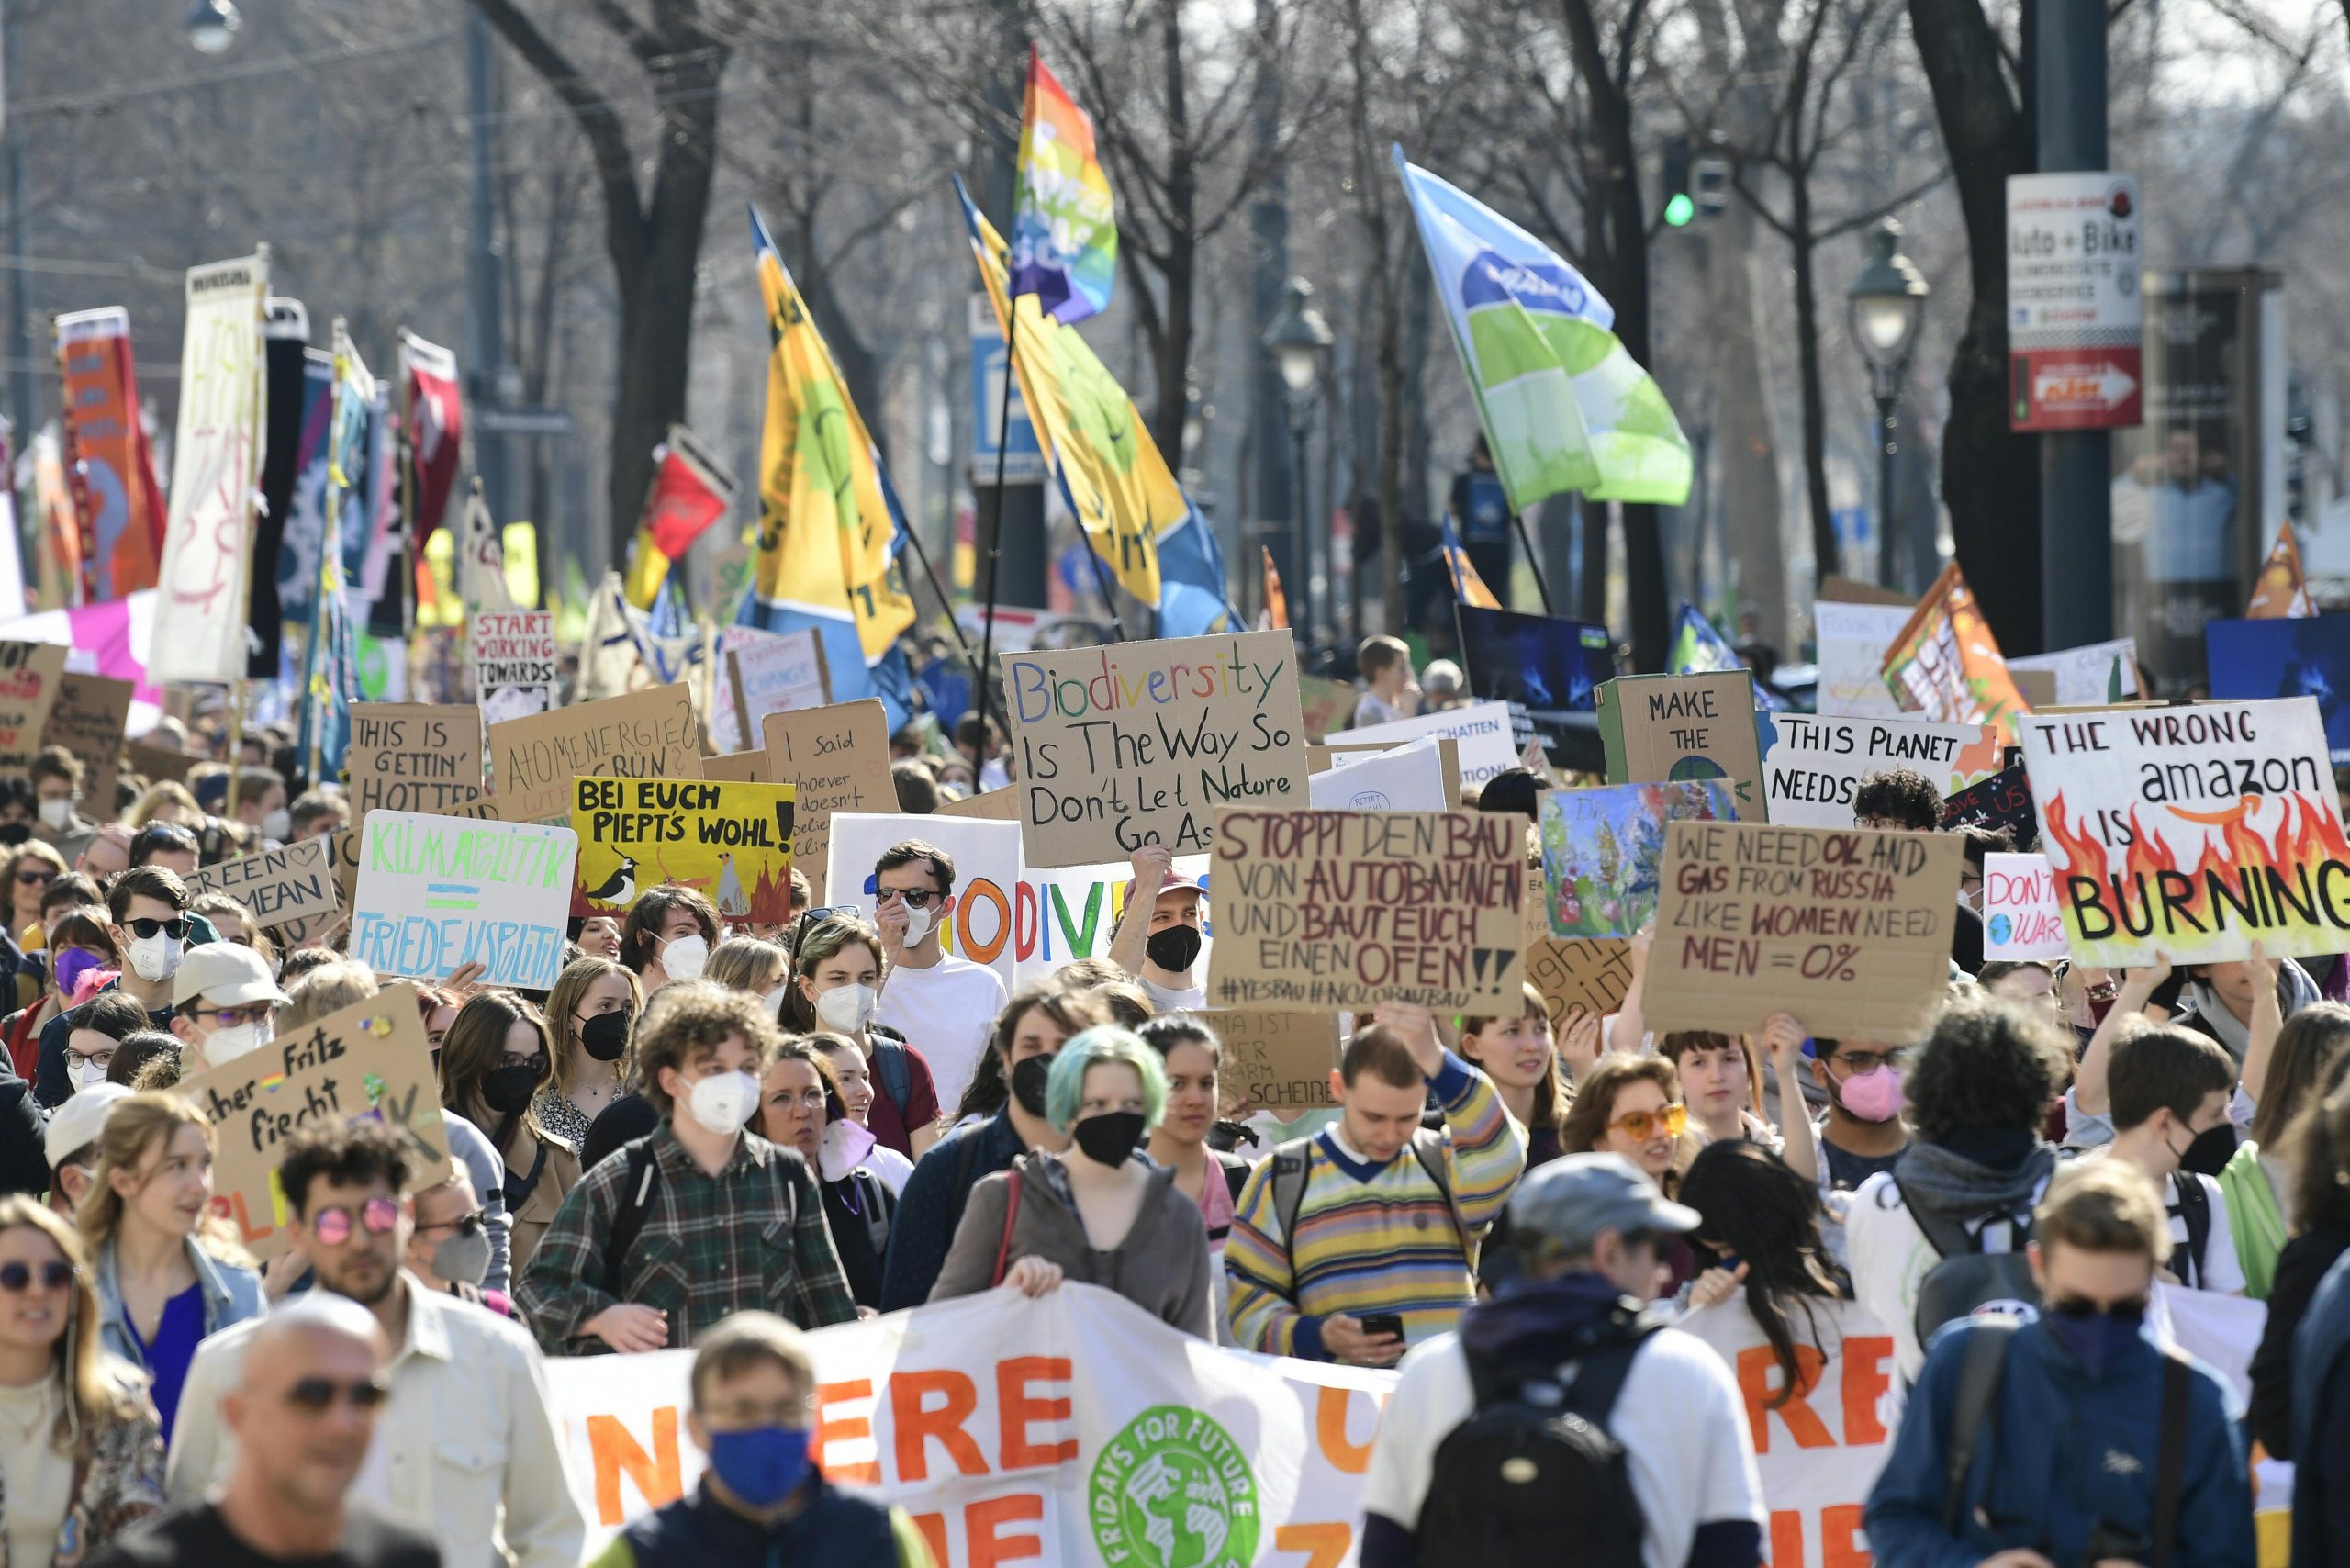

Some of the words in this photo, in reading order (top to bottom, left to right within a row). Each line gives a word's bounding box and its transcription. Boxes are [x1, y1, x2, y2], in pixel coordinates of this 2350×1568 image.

[477, 614, 553, 635] START
[475, 639, 553, 660] WORKING
[478, 663, 554, 683] TOWARDS
[1013, 640, 1283, 723] Biodiversity
[1649, 690, 1719, 722] MAKE
[354, 718, 405, 749] THIS
[424, 722, 448, 748] IS
[786, 731, 792, 762] I
[1065, 720, 1155, 775] The
[1156, 706, 1238, 763] Way
[1251, 713, 1291, 751] So
[1670, 728, 1709, 750] THE
[1780, 719, 1854, 755] THIS
[1869, 726, 1958, 763] PLANET
[2035, 722, 2110, 755] THE
[2131, 710, 2256, 746] WRONG
[375, 750, 467, 778] GETTIN'
[2140, 756, 2320, 803] amazon
[578, 780, 624, 812] BEI
[637, 782, 722, 810] EUCH
[801, 786, 864, 812] doesn't
[1030, 778, 1129, 825] Don't
[1138, 773, 1188, 812] Let
[1201, 763, 1291, 804] Nature
[1772, 769, 1858, 805] NEEDS
[698, 801, 796, 854] WOHL!
[1219, 812, 1360, 861] STOPPT
[1361, 813, 1434, 859] DEN
[1440, 812, 1513, 863] BAU
[2098, 809, 2133, 846] IS
[184, 851, 287, 895] GREEN
[1677, 828, 1725, 863] WE
[1736, 830, 1821, 868] NEED
[1870, 834, 1928, 878] AND
[1232, 861, 1296, 901] VON
[1304, 859, 1521, 914] AUTOBAHNEN
[1677, 863, 1729, 897] GAS
[1737, 868, 1806, 898] FROM
[1811, 869, 1896, 902] RUSSIA
[2066, 859, 2350, 941] BURNING
[1229, 902, 1297, 937] UND
[1298, 903, 1386, 943] BAUT
[1392, 906, 1478, 945] EUCH
[1673, 899, 1741, 932] LIKE
[1751, 902, 1862, 937] WOMEN
[1863, 907, 1940, 939] NEED
[2014, 910, 2063, 945] WAR
[1259, 939, 1351, 976] EINEN
[1682, 935, 1761, 978] MEN
[1259, 1012, 1298, 1036] IST
[282, 1025, 347, 1079] Fritz
[1094, 1442, 1135, 1564] FRIDAYS
[1134, 1412, 1181, 1450] FOR
[1185, 1416, 1255, 1518] FUTURE
